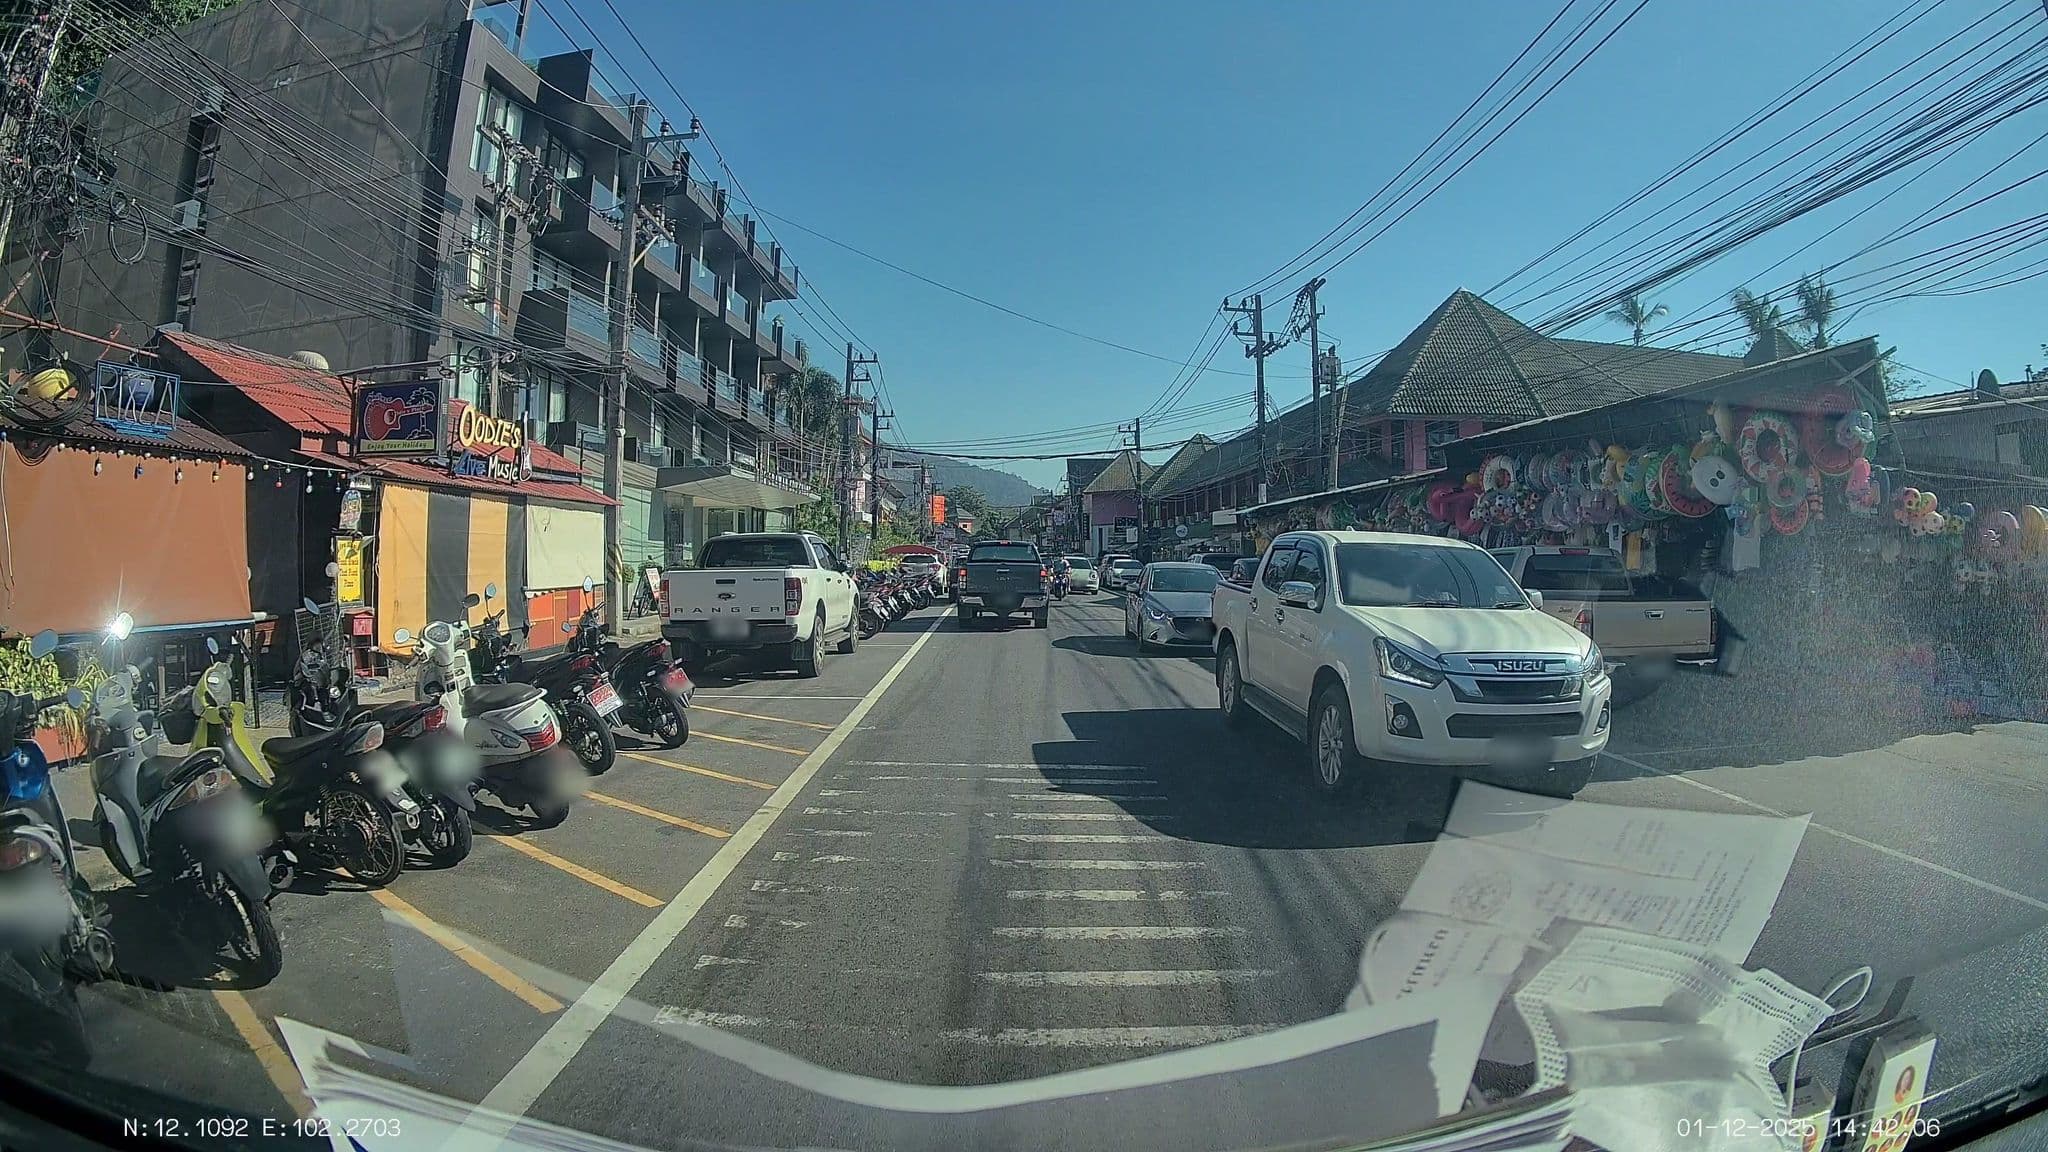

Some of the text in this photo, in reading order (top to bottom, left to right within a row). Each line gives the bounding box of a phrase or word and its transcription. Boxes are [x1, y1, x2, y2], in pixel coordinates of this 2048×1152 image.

[403, 441, 427, 449] Holiday
[488, 454, 519, 480] Music
[1498, 660, 1543, 671] ISUZU
